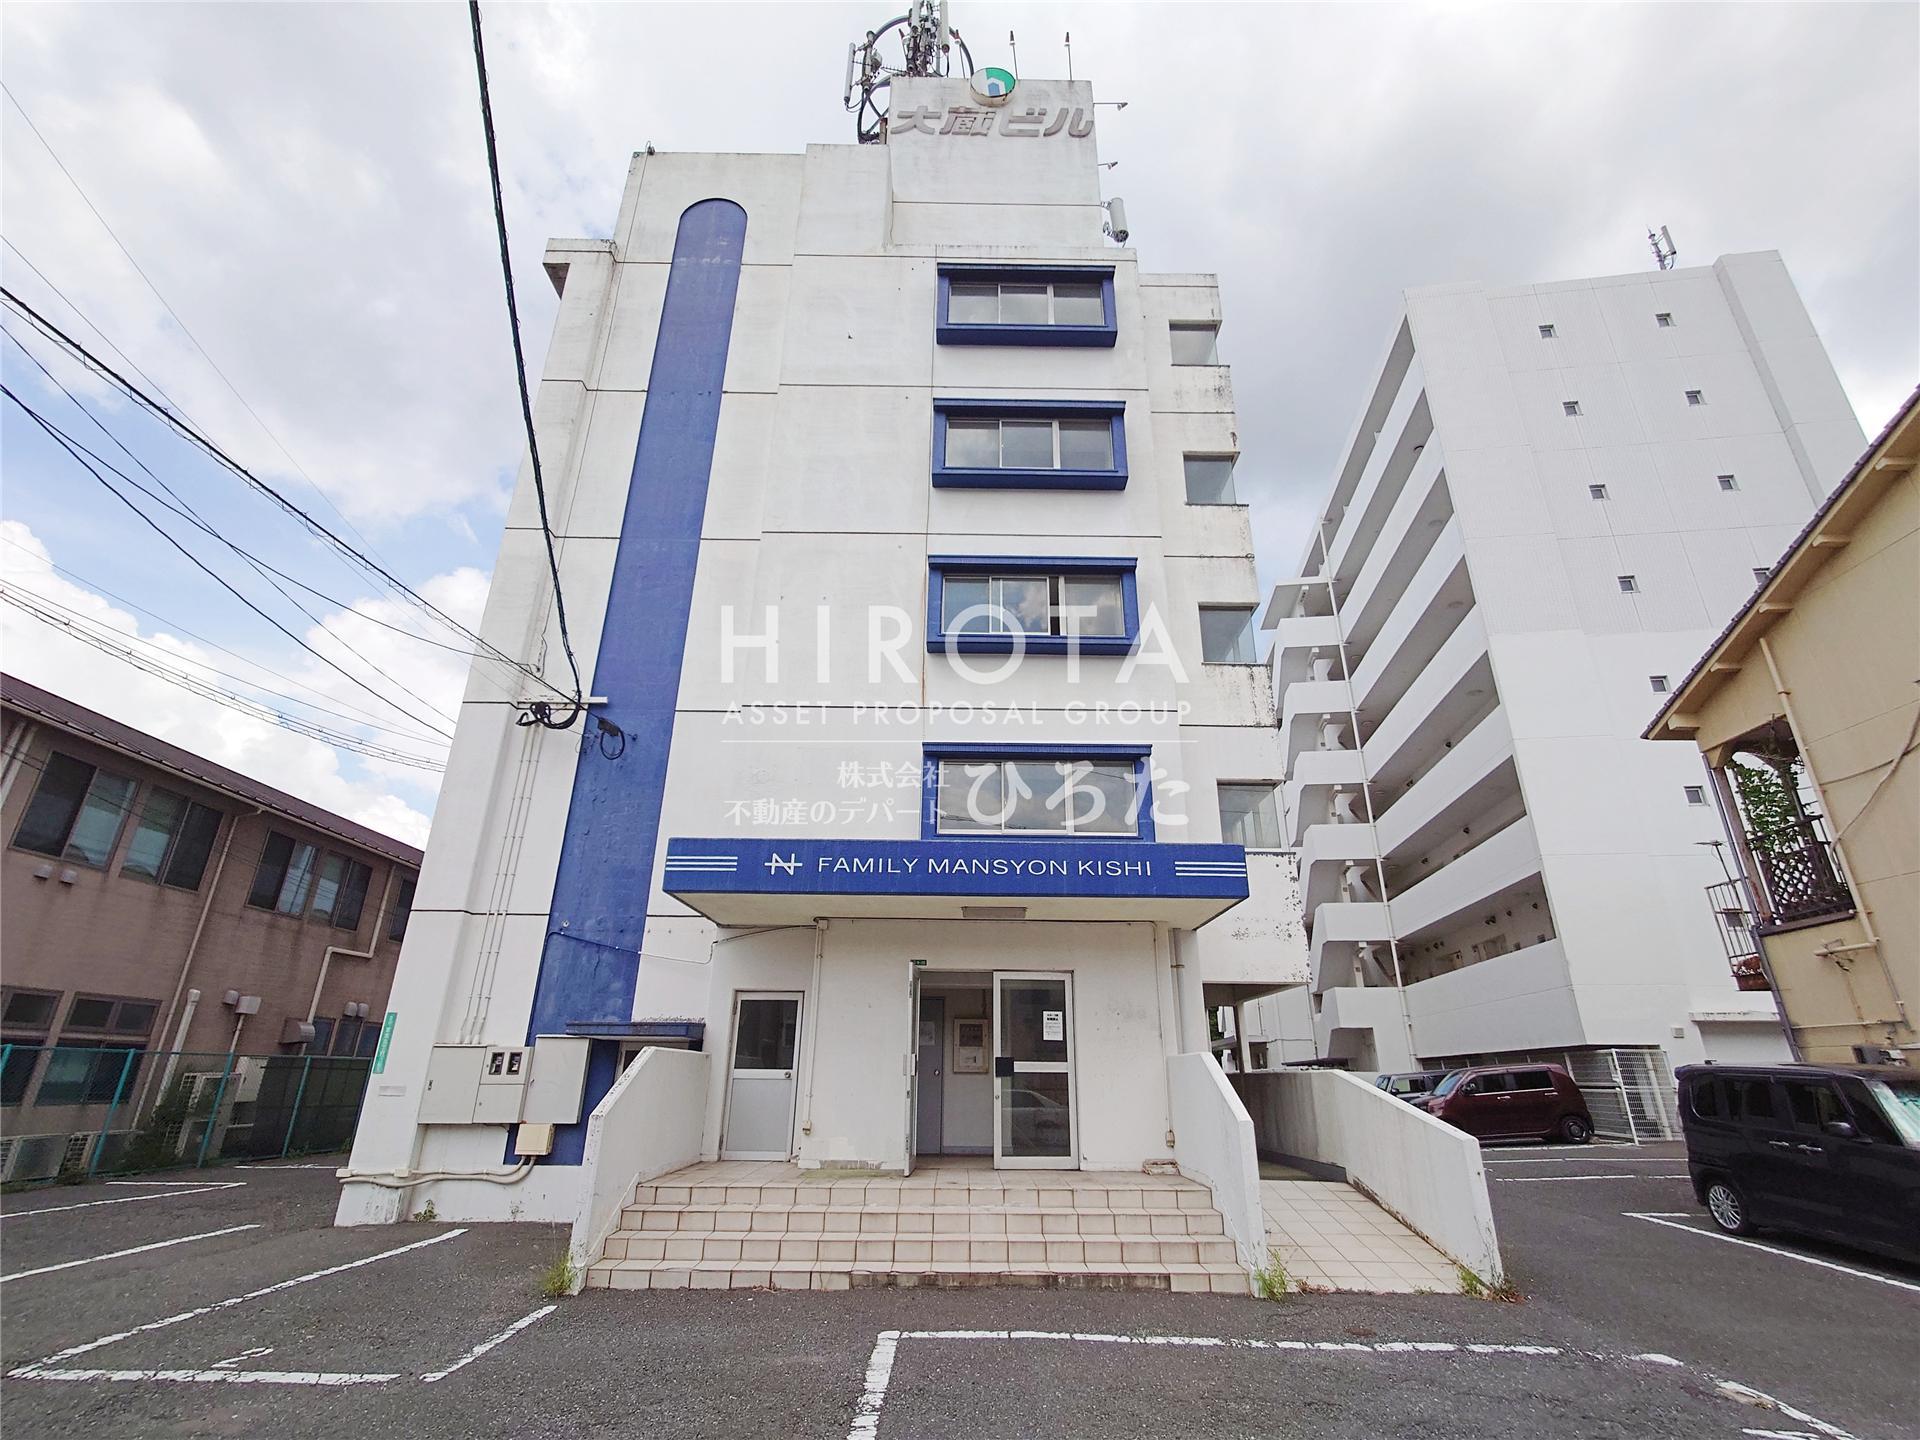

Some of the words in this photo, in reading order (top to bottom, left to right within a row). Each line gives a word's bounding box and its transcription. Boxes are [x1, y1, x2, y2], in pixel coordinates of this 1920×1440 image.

[818, 857, 919, 873] FAMILY
[927, 858, 1067, 876] MANSYON
[1078, 860, 1151, 876] KISHI
